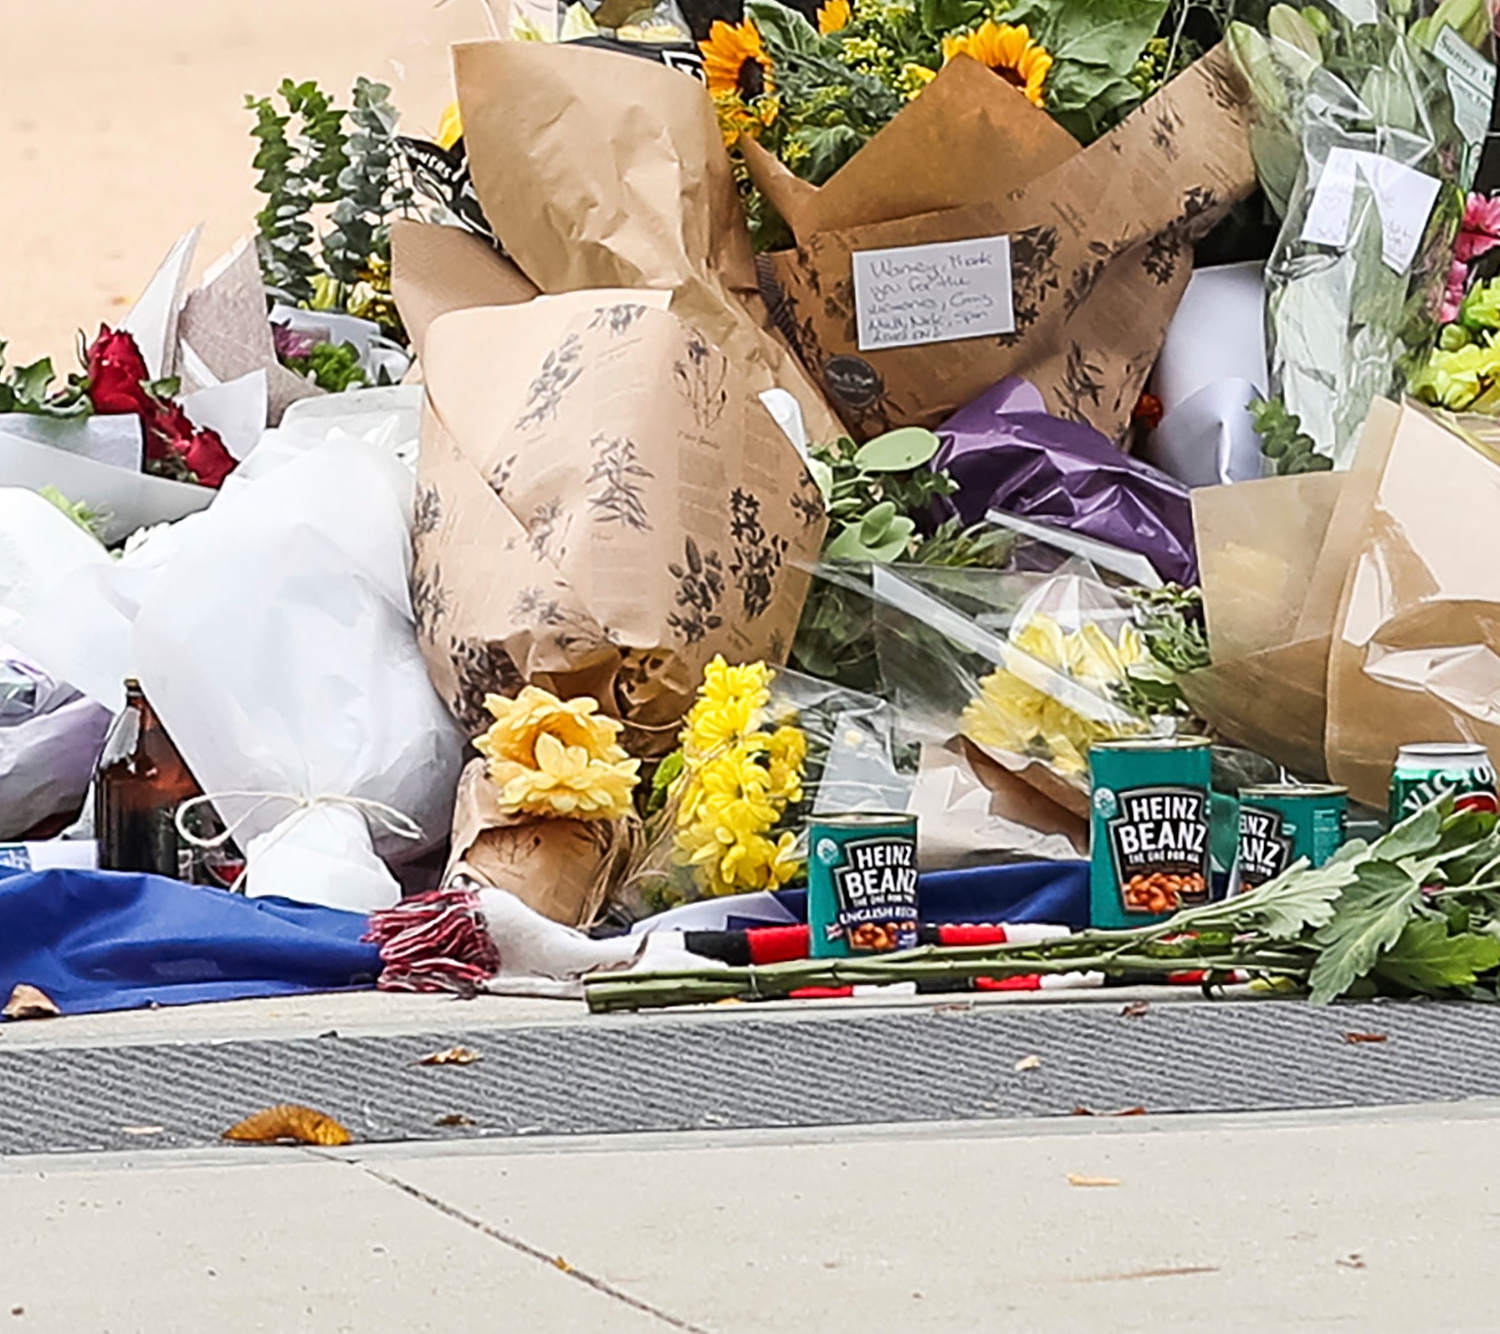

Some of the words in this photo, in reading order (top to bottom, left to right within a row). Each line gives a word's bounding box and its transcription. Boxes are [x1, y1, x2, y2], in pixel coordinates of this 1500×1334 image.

[1131, 796, 1199, 822] HEINZ
[1118, 821, 1208, 854] BEANZ
[856, 844, 912, 870] HEINZ
[844, 867, 918, 899] BEANZ
